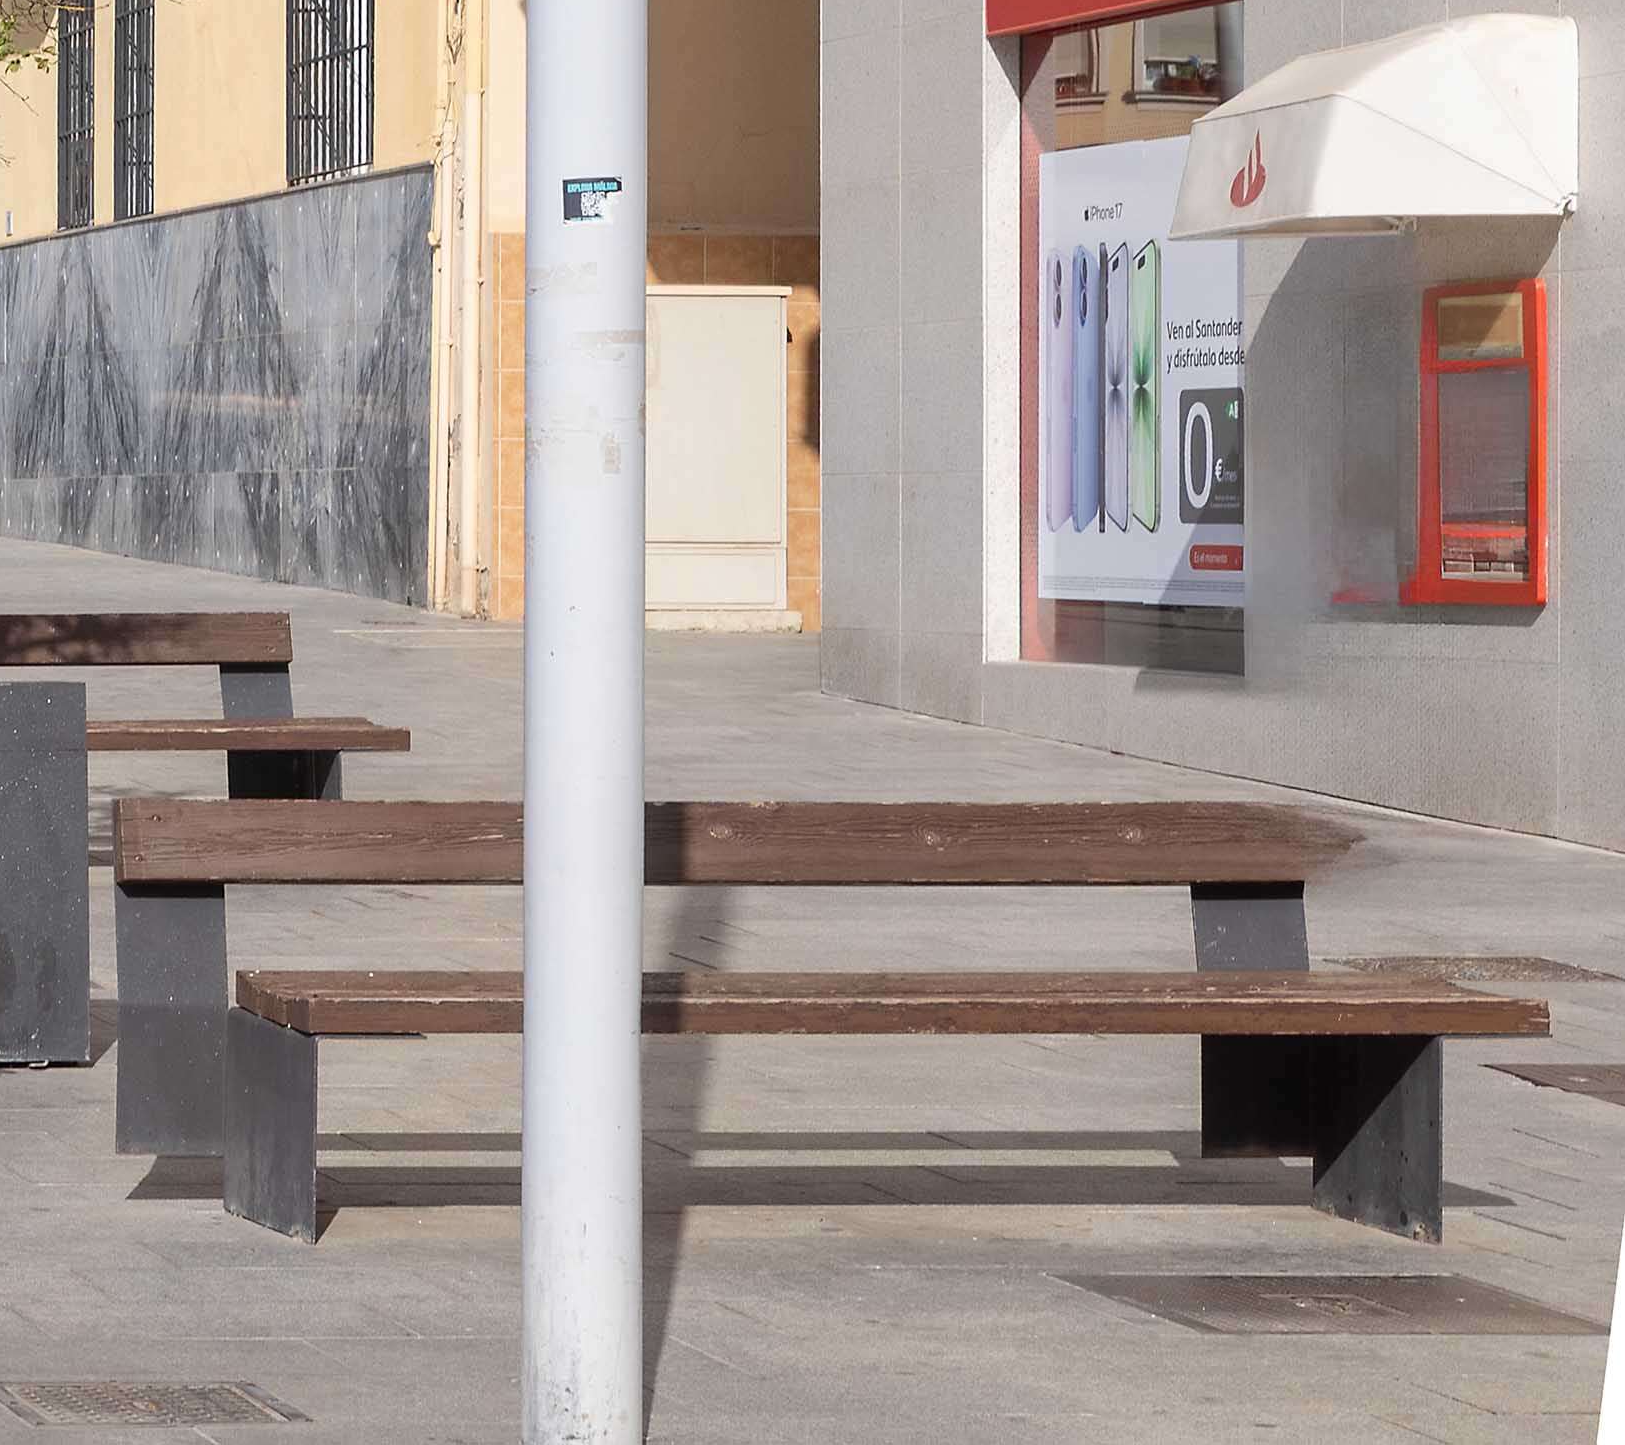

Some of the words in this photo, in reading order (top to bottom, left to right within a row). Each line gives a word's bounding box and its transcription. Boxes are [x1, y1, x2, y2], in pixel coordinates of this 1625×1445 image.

[1090, 205, 1114, 221] iPhone
[1166, 320, 1184, 341] Ven
[1185, 318, 1194, 339] al
[1195, 316, 1243, 339] Santander
[1166, 354, 1173, 375] y
[1173, 346, 1217, 368] disfrútalo
[1218, 344, 1245, 366] desde
[1184, 401, 1213, 509] 0
